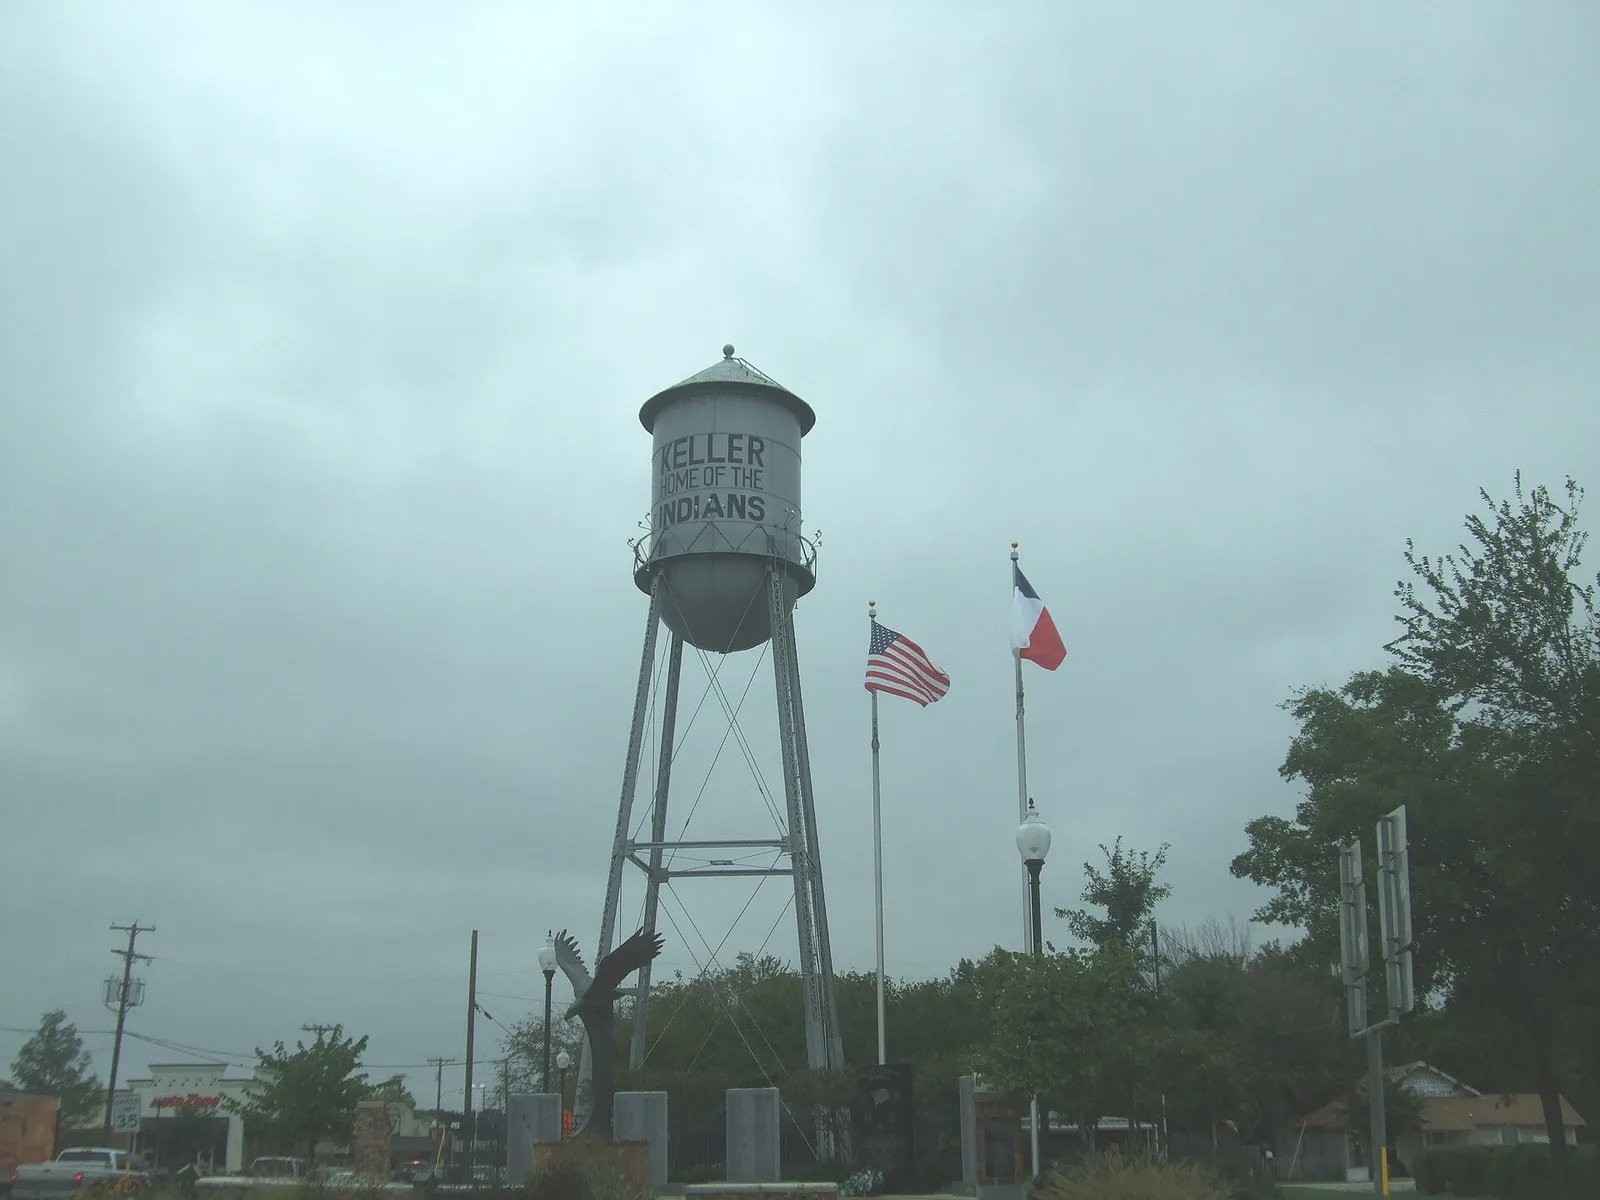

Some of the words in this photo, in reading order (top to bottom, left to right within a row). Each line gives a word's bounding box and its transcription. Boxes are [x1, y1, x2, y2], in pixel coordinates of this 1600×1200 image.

[661, 433, 765, 475] KELLER
[660, 468, 699, 498] HOME
[703, 466, 726, 487] OF
[731, 466, 763, 490] THE
[659, 493, 765, 528] INDIANS
[116, 1113, 138, 1128] 35
